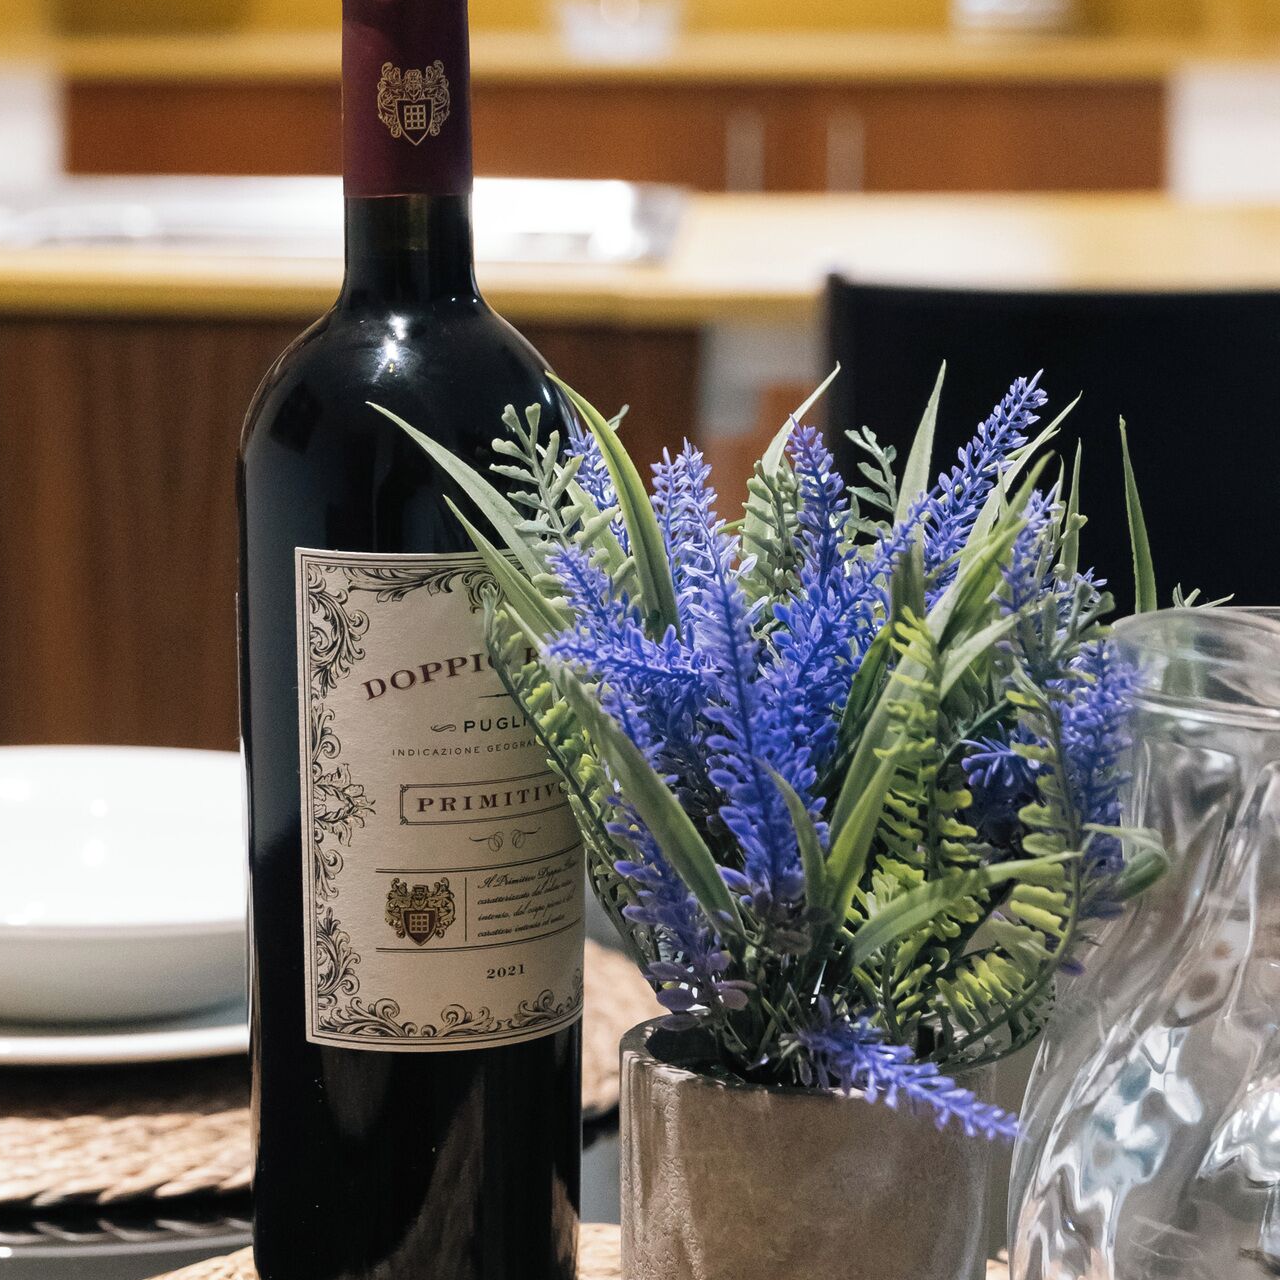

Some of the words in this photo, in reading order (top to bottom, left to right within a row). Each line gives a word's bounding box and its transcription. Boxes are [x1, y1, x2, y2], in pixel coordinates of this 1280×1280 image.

[463, 716, 528, 733] PUGLI
[392, 745, 480, 757] INDICAZIONE
[486, 737, 536, 753] GEOGRA
[486, 964, 526, 979] 2021
